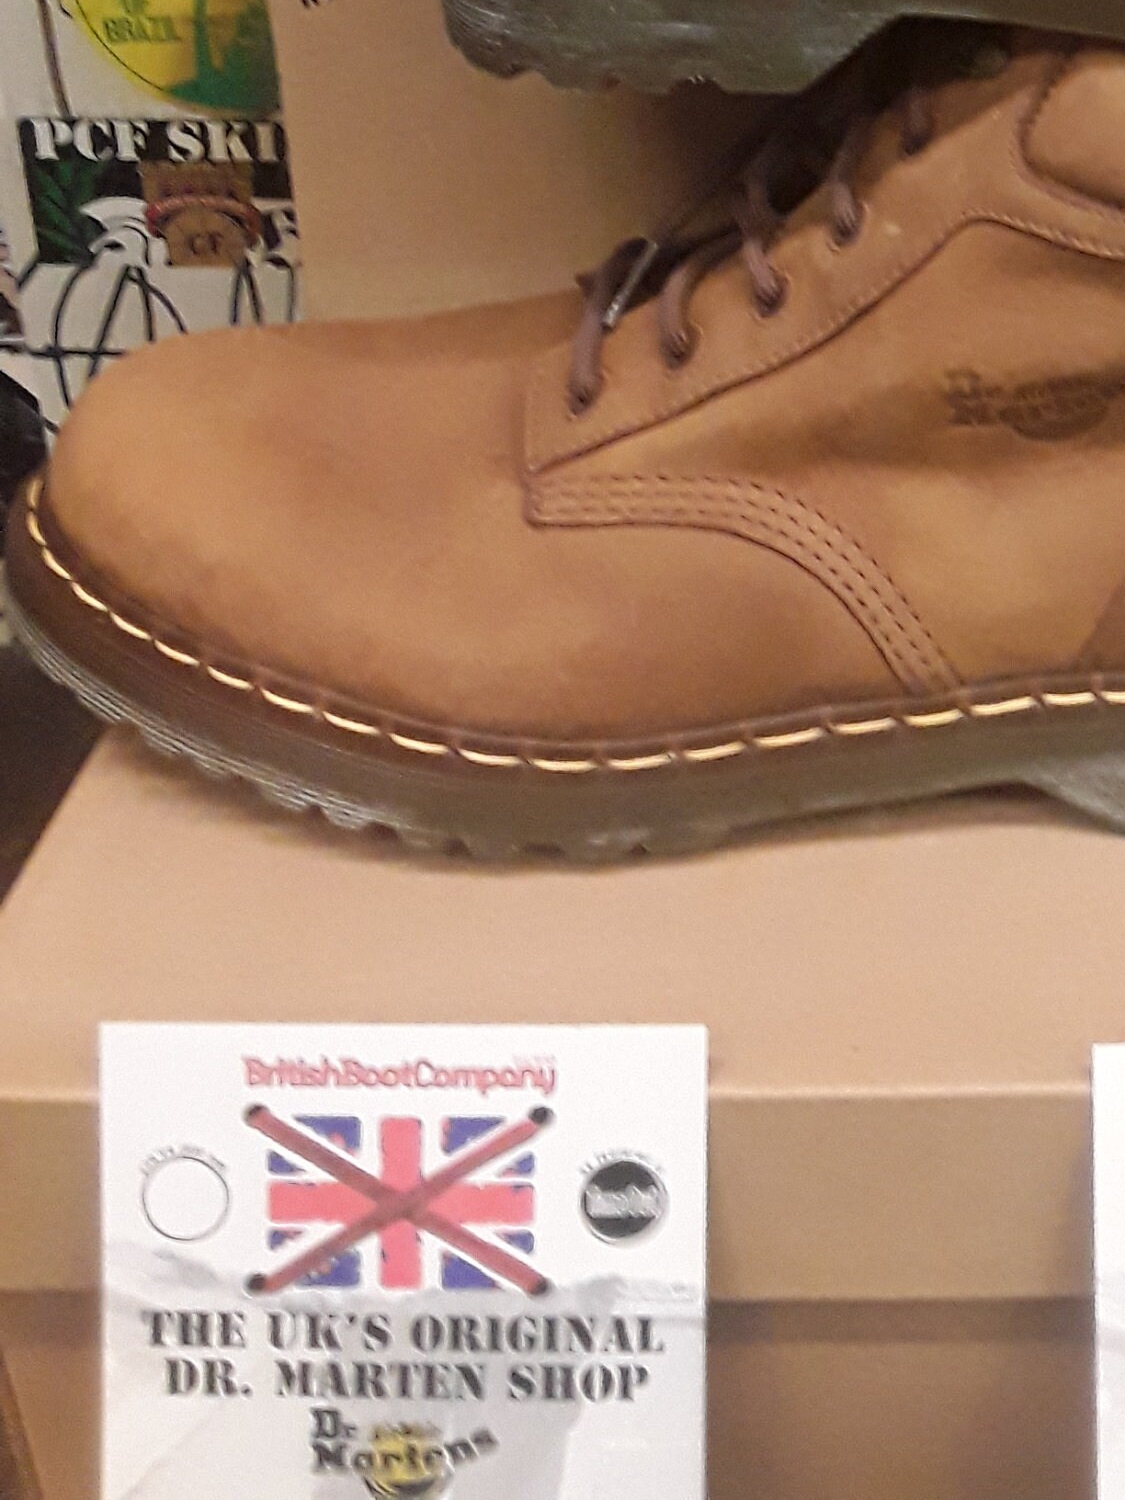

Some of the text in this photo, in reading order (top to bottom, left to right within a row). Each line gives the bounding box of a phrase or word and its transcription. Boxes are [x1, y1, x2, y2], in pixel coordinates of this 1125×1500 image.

[242, 1054, 557, 1097] BritishBootCompany
[143, 1309, 665, 1355] THE UK'S ORIGINAL
[163, 1355, 649, 1403] DR. MARTEN SHOP
